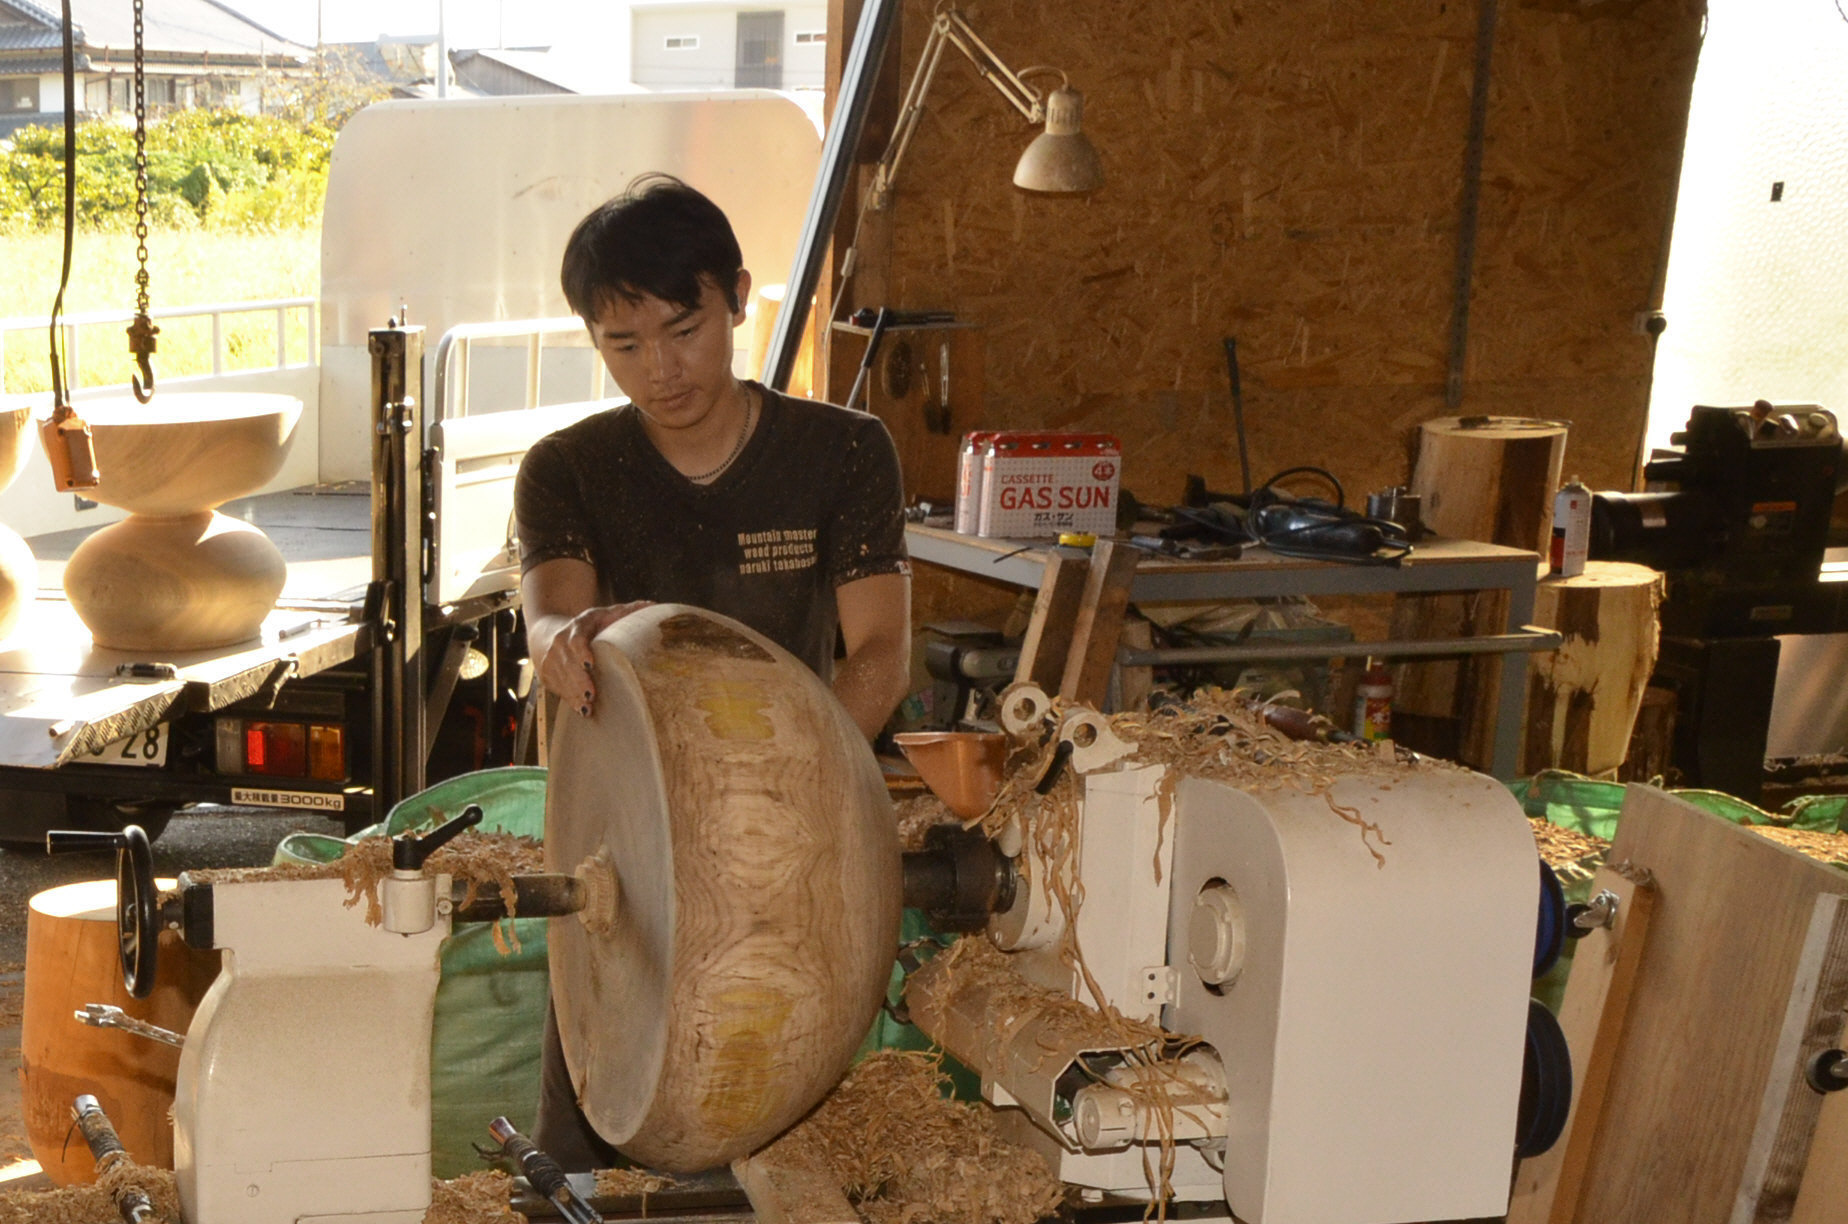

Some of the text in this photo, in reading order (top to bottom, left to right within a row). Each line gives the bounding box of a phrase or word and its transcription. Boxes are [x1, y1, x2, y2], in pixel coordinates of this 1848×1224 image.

[1001, 474, 1054, 484] CASSETTE
[1000, 486, 1110, 510] GAS SUN
[737, 529, 818, 546] Mountain master
[772, 543, 814, 557] products
[739, 559, 771, 574] naruki
